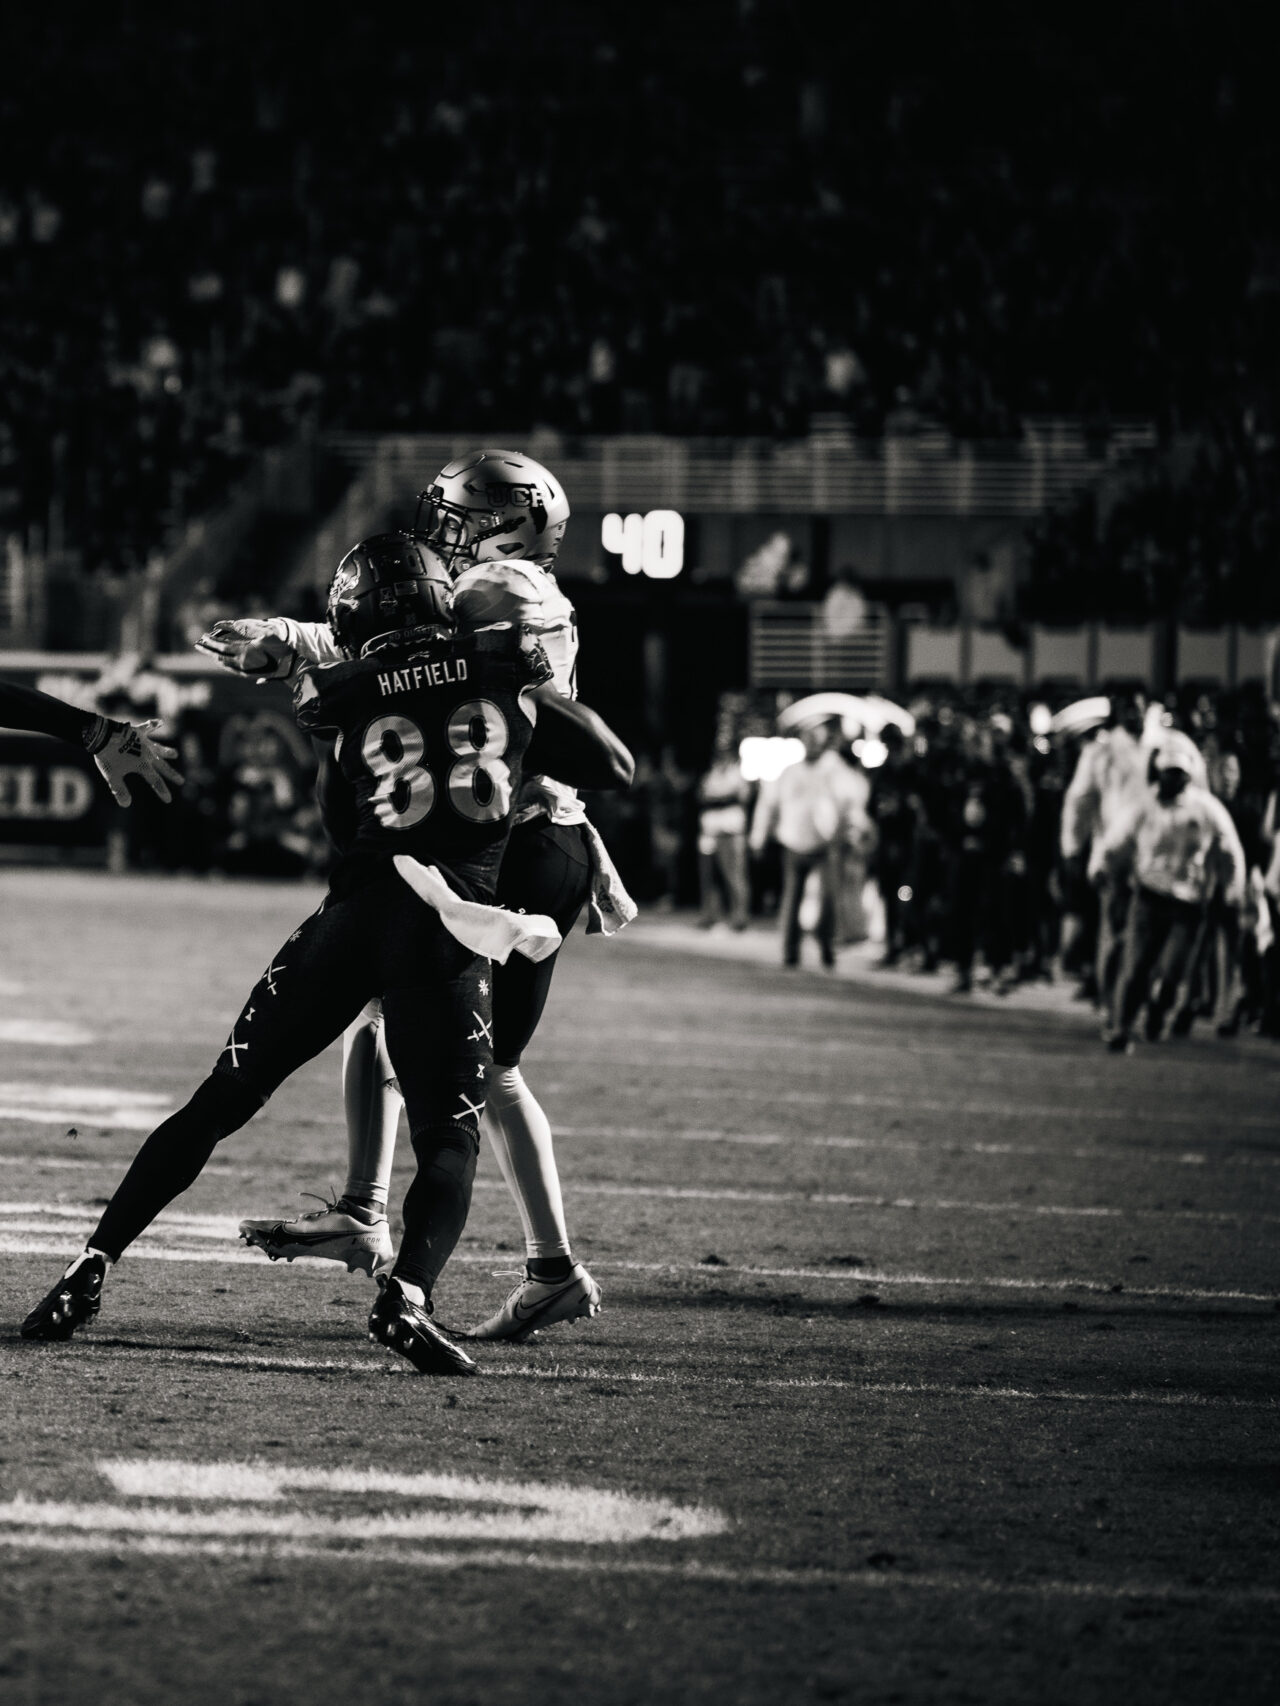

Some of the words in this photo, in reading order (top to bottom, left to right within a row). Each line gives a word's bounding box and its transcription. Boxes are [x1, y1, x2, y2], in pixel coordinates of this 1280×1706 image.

[602, 509, 685, 579] 40
[376, 658, 469, 697] HATFIELD
[360, 698, 513, 831] 88
